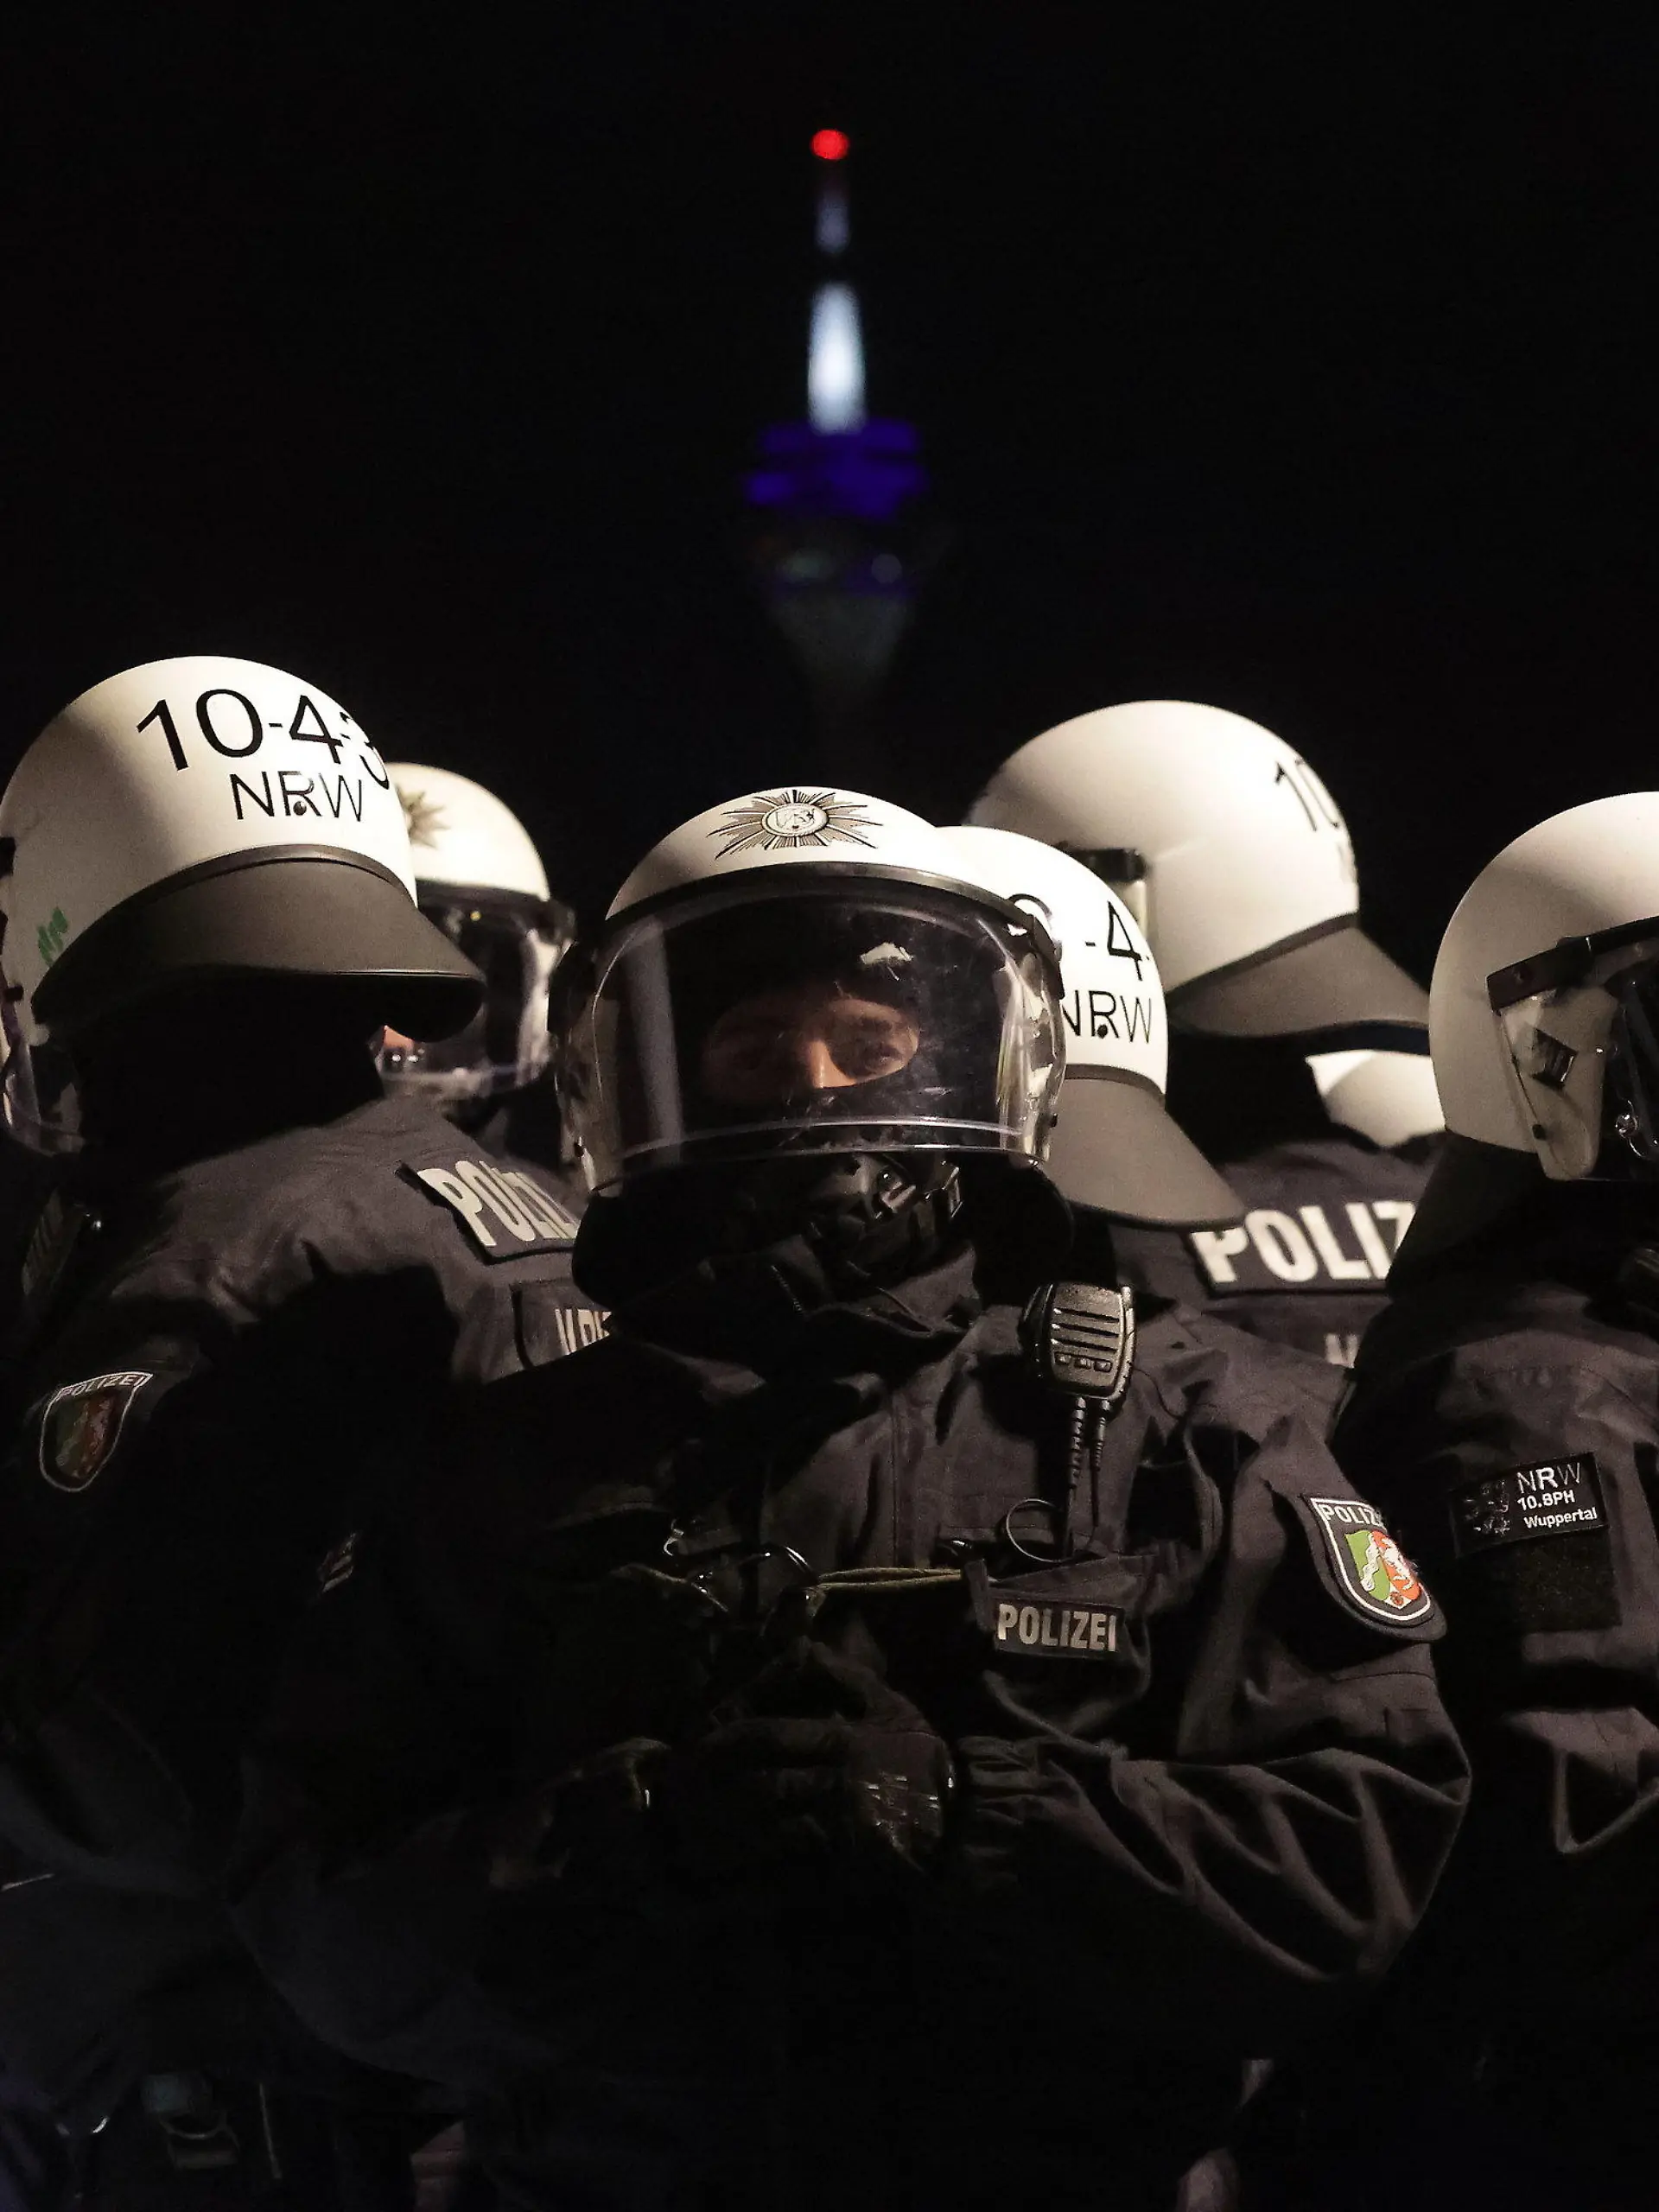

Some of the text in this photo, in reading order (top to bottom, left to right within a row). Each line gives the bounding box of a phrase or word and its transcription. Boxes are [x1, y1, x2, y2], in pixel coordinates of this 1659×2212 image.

[229, 770, 363, 822] NRW
[1516, 1461, 1580, 1494] NRW
[1522, 1506, 1599, 1529] Wuppertal
[996, 1603, 1117, 1652] POLIZEI
